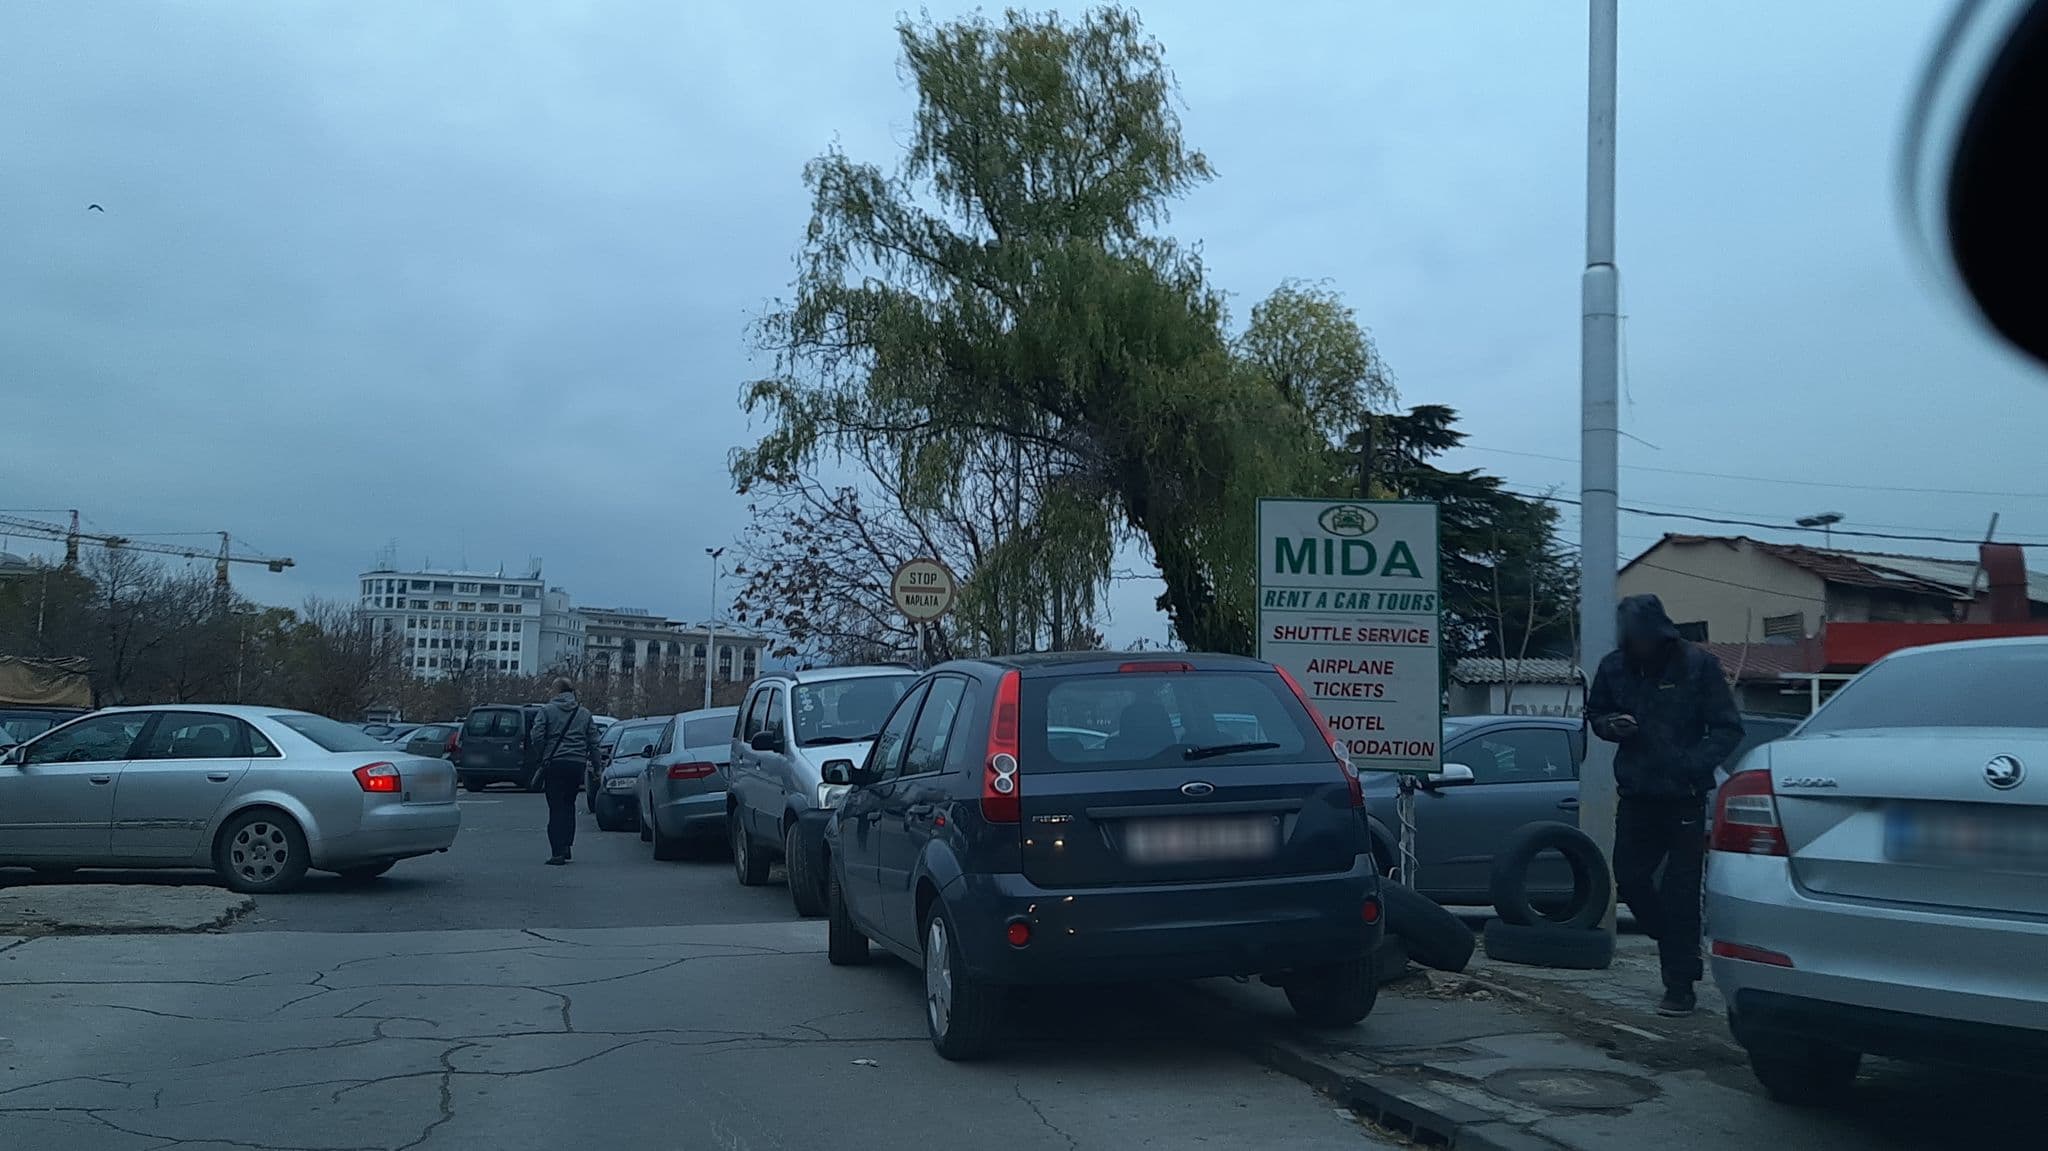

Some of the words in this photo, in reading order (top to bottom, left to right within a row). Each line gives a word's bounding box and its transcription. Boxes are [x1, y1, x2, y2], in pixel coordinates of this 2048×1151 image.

[1274, 536, 1424, 579] MIDA
[909, 572, 938, 585] STOP
[905, 594, 939, 607] NAPLATA
[1263, 590, 1313, 609] RENT
[1315, 591, 1328, 609] A
[1334, 592, 1370, 610] CAR
[1376, 593, 1437, 611] TOURS
[1272, 625, 1352, 642] SHUTTLE
[1356, 628, 1430, 644] SERVICE
[1306, 658, 1395, 676] AIRPLANE
[1312, 681, 1385, 698] TICKETS
[1327, 715, 1386, 732] HOTEL
